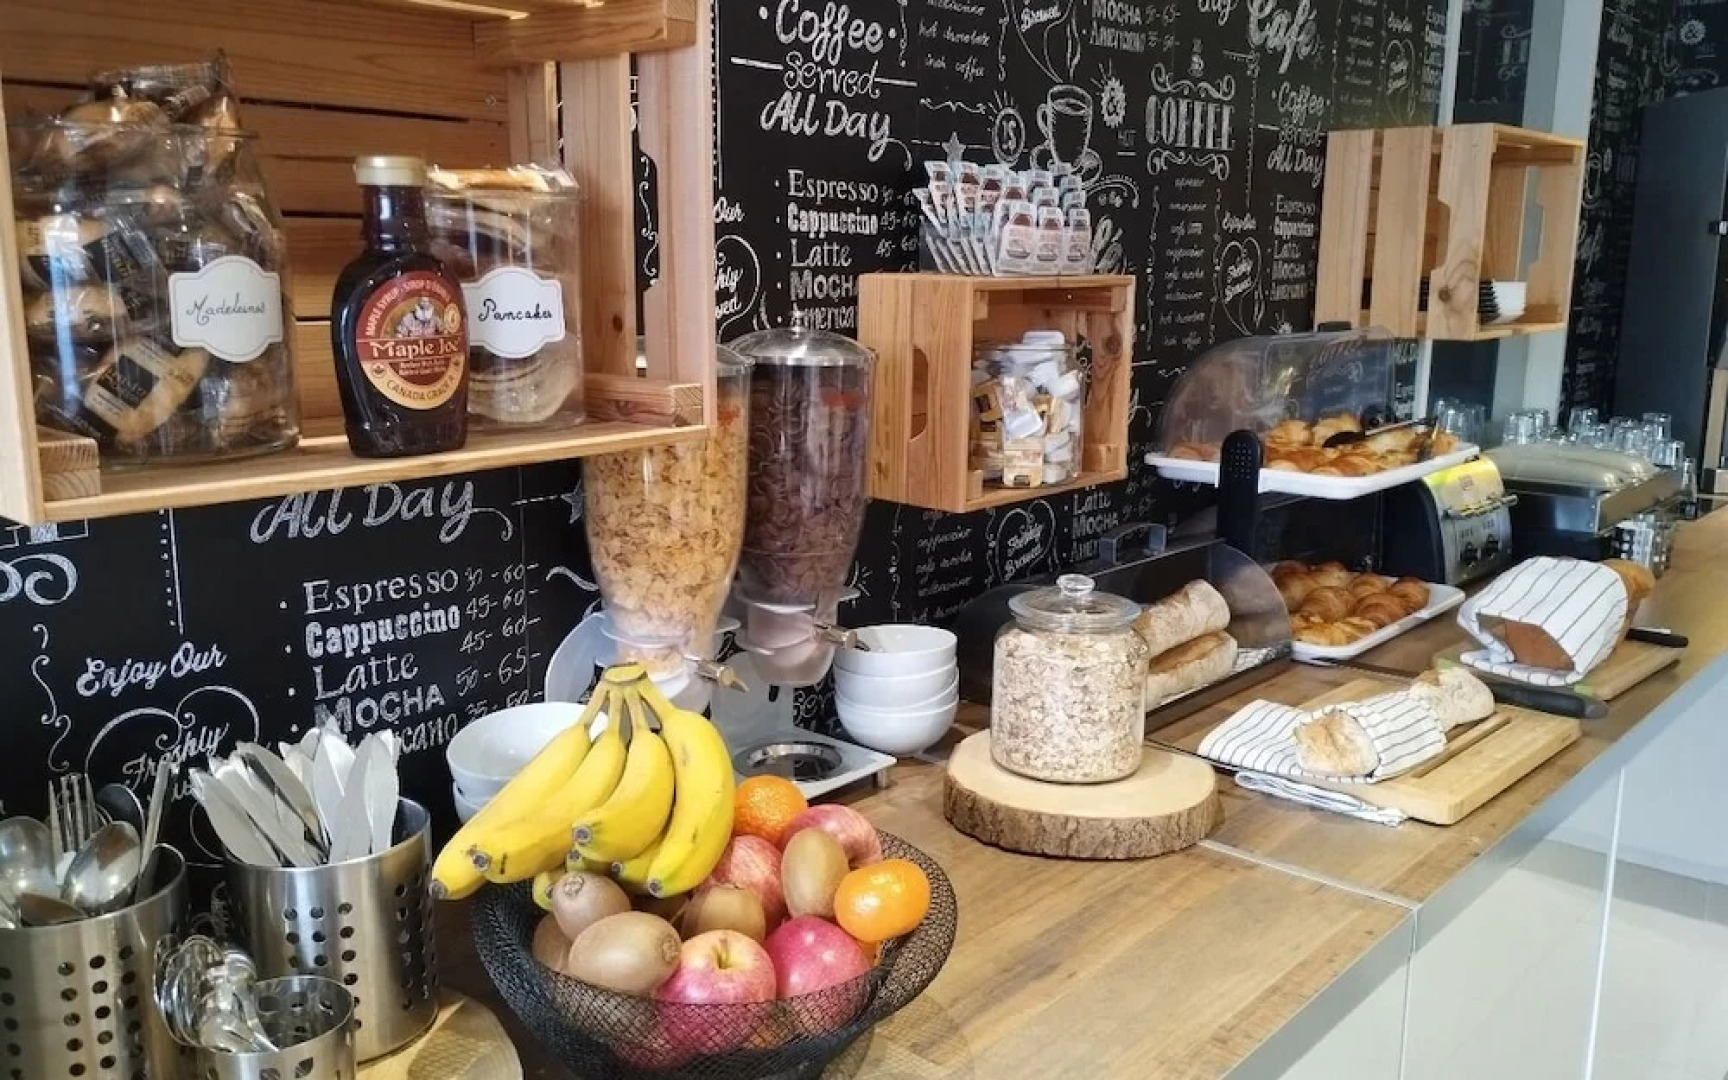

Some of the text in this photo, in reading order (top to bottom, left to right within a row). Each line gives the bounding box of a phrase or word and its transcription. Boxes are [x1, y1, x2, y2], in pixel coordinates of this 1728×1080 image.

[776, 0, 884, 65] Coffee
[784, 51, 881, 99] Served
[1146, 94, 1236, 150] COFFEE
[1278, 81, 1325, 124] Coffee
[760, 90, 912, 171] All Day
[787, 168, 880, 205] Espresso
[1267, 143, 1324, 189] All Day
[787, 201, 879, 239] Cappuccino
[790, 237, 853, 268] Latte
[790, 268, 857, 301] MOCH
[478, 298, 553, 322] Pancakes
[369, 339, 435, 360] Maple
[386, 379, 427, 401] CANADA
[250, 480, 514, 544] All Day
[303, 568, 459, 616] Espresso
[305, 601, 462, 659] Cappuccino
[75, 641, 228, 698] Enjoy Our
[312, 651, 420, 701] Latte
[313, 683, 447, 733] MOCHA
